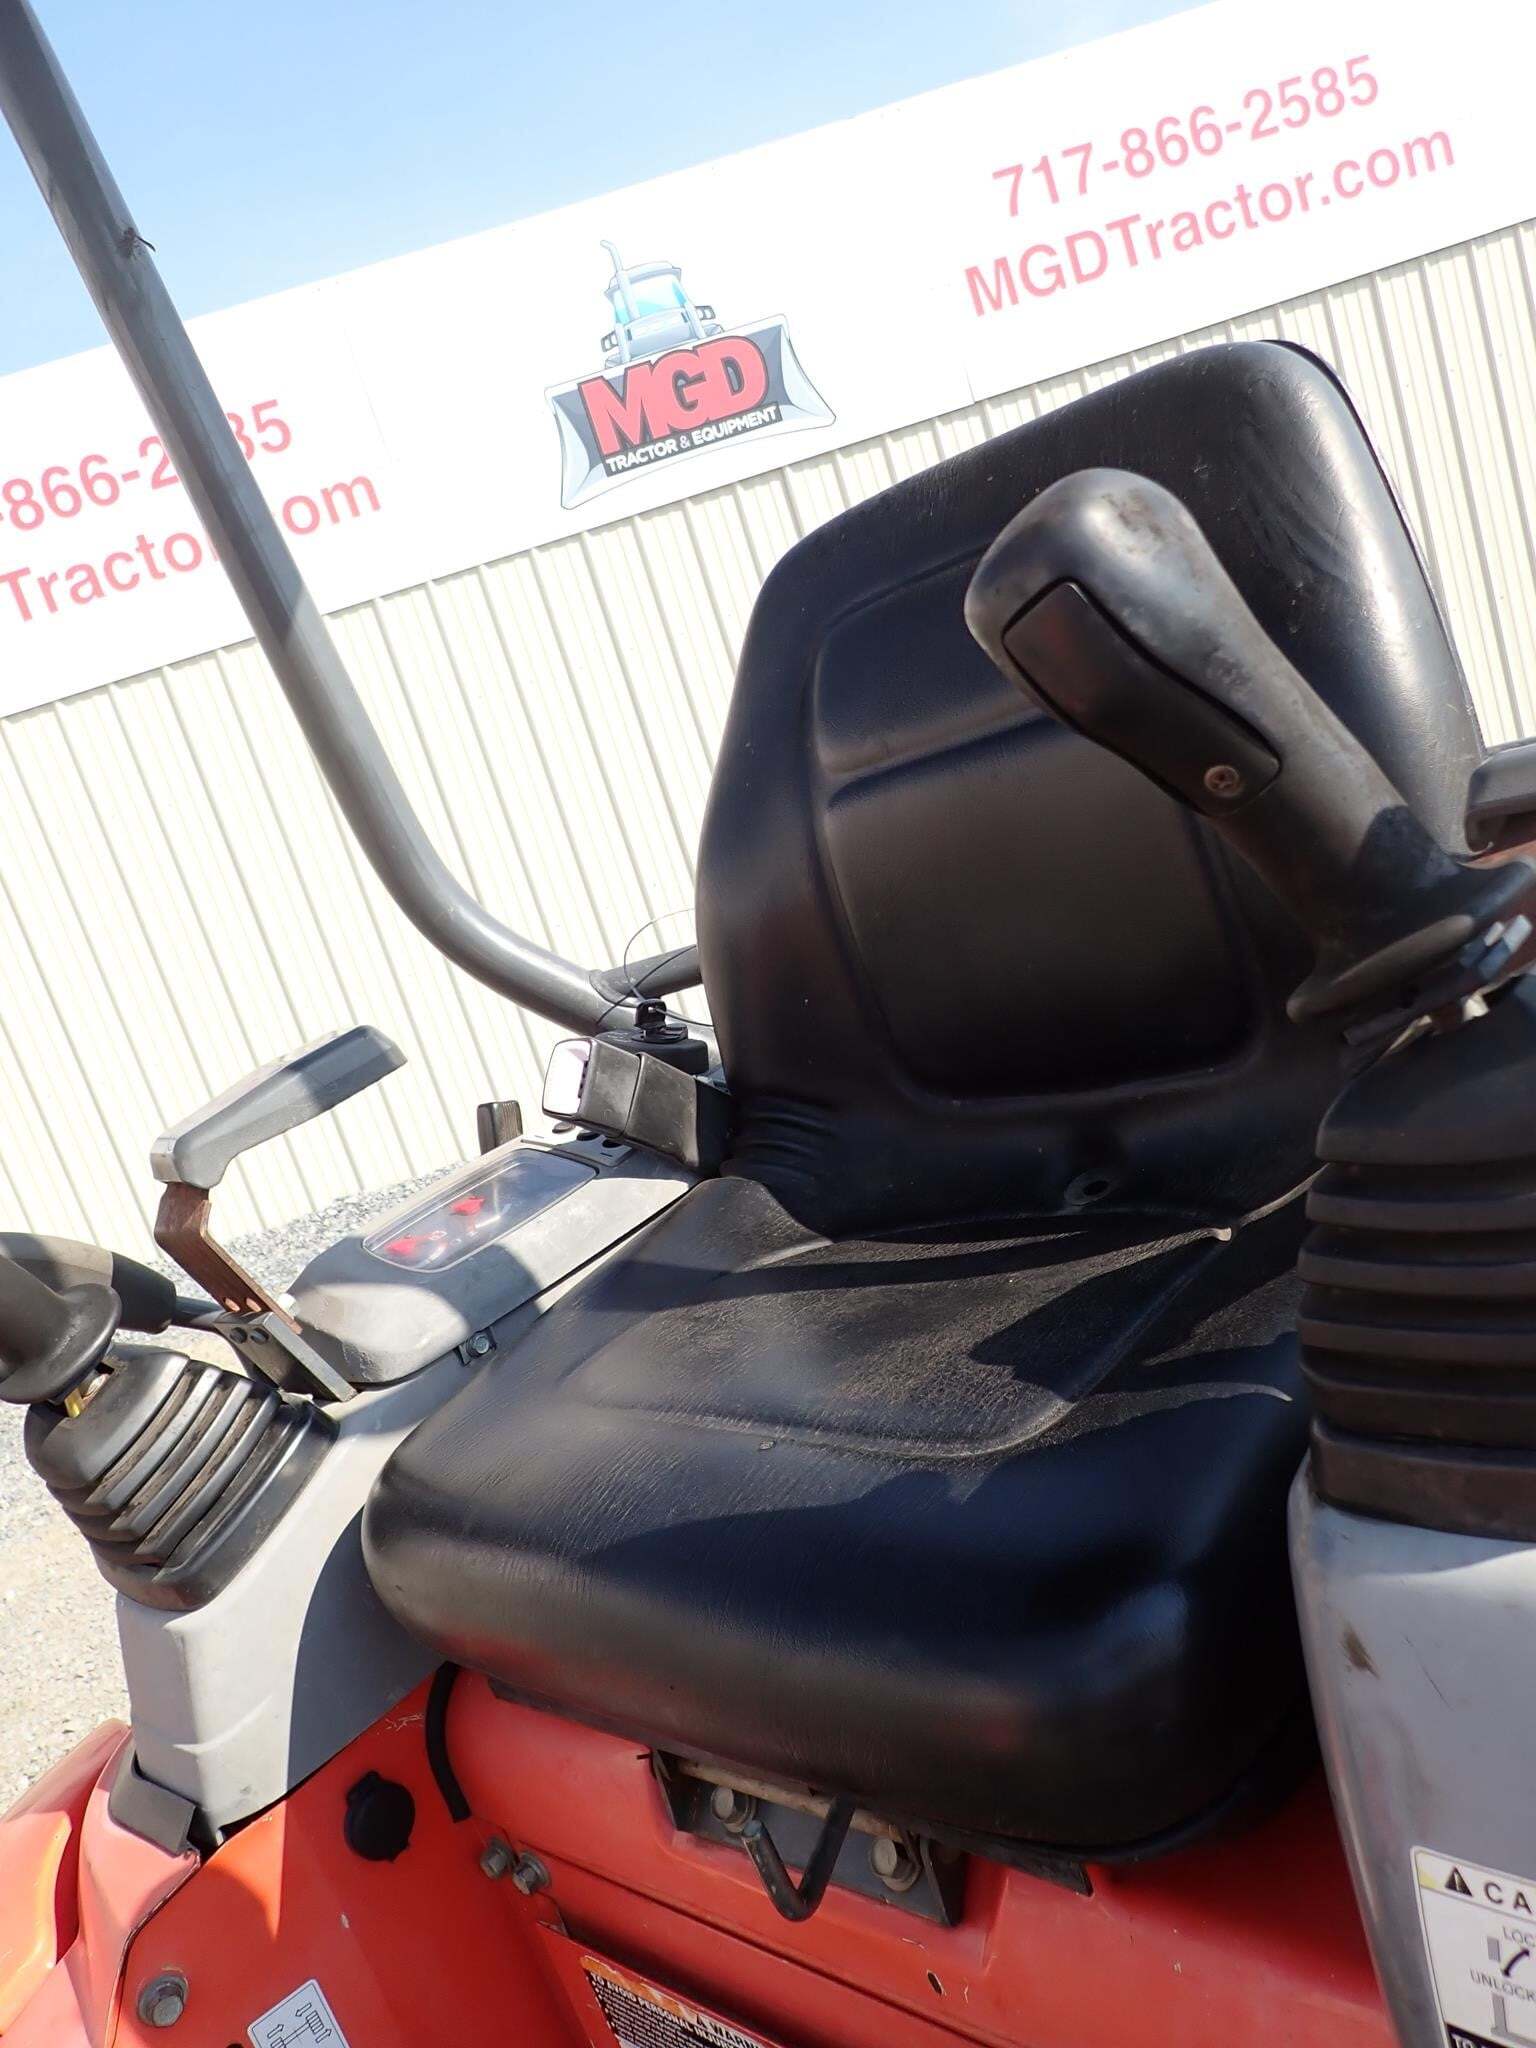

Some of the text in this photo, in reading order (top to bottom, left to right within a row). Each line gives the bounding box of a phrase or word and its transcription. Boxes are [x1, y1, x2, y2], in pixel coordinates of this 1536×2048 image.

[992, 54, 1380, 218] 717-866-2585
[965, 131, 1456, 317] MGDTractor.com
[577, 335, 769, 456] MGD
[606, 405, 778, 473] TRACTOR & EQUIPMENT
